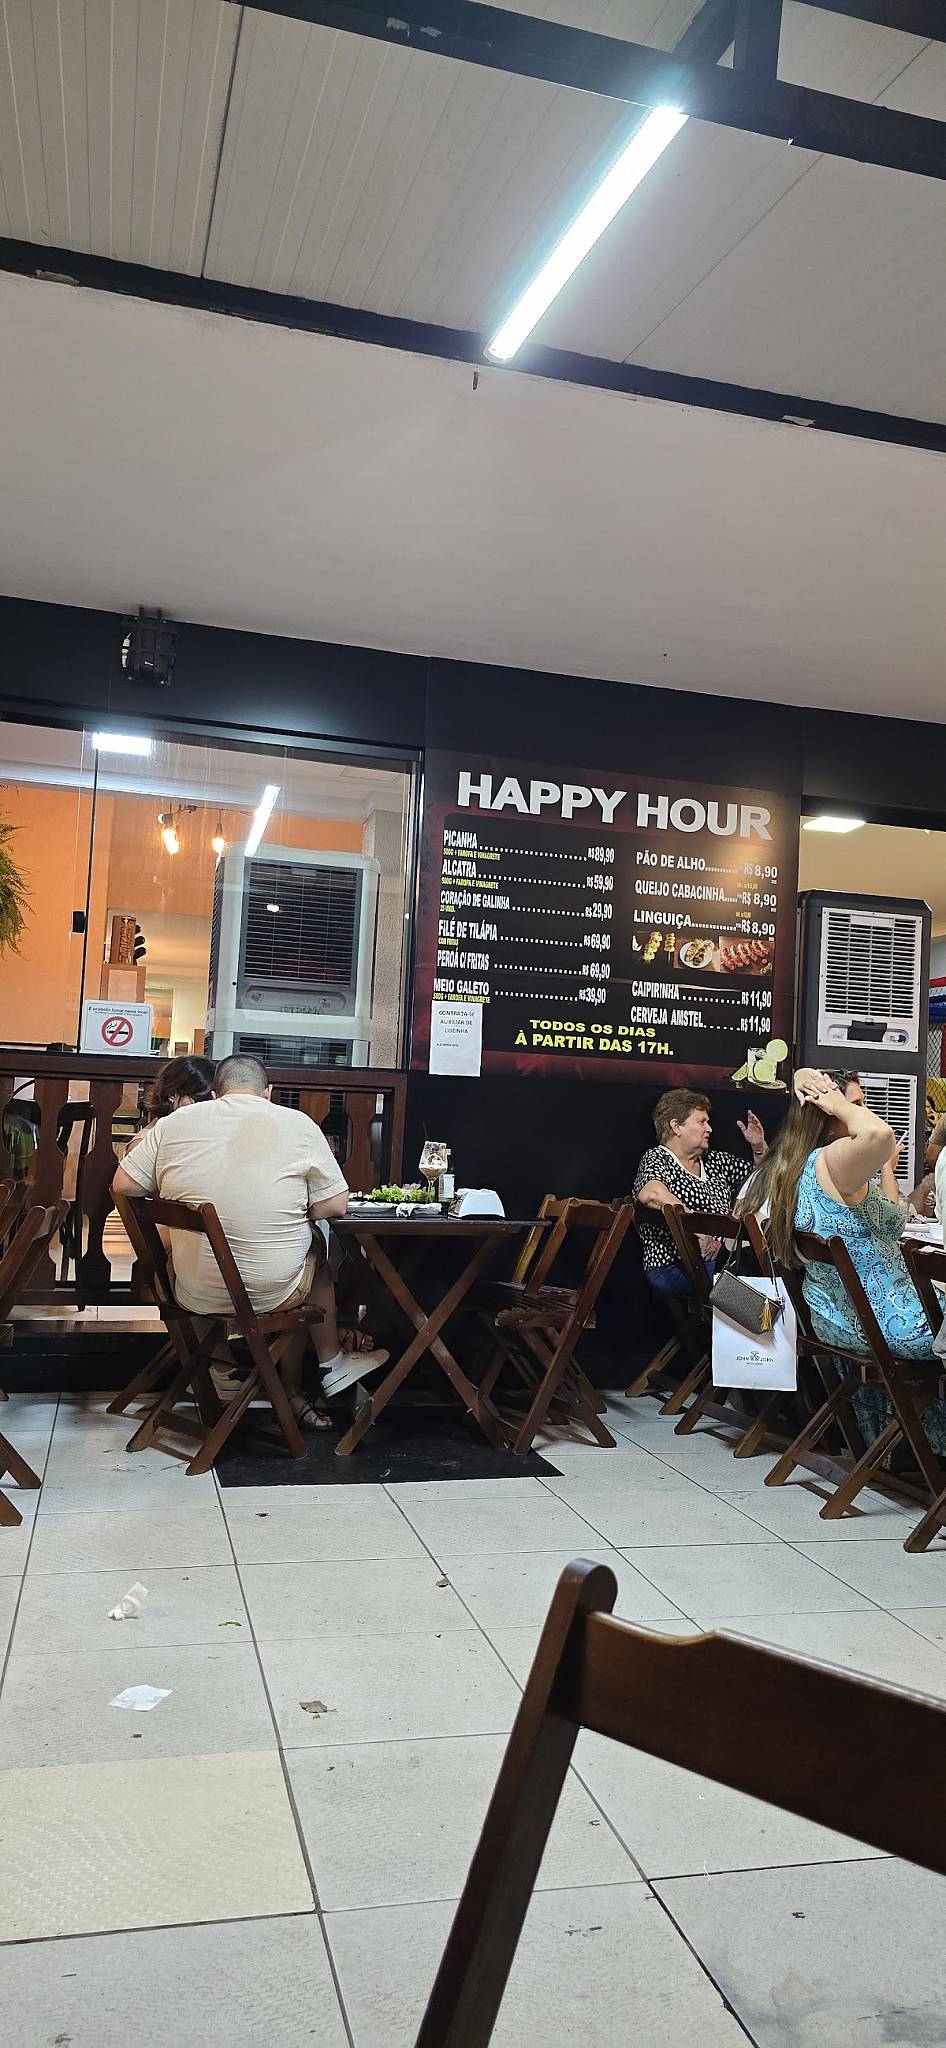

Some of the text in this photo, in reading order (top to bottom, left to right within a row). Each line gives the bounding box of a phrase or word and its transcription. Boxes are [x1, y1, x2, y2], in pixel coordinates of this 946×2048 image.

[457, 771, 773, 841] HAPPY HOUR
[444, 830, 478, 849] PICANHA
[442, 859, 476, 878] ALCATRA
[636, 850, 657, 866] PÃO
[660, 854, 674, 868] DE
[677, 856, 706, 871] ALHO
[440, 889, 471, 908] CORAÇÃO
[472, 893, 481, 907] DE
[482, 894, 510, 910] GALINHA
[635, 880, 669, 896] QUEIJO
[671, 883, 725, 901] CABACINHA
[438, 916, 455, 937] FILÉ
[456, 921, 467, 938] DE
[468, 920, 498, 941] TILÁPIA
[633, 909, 692, 929] LINGUIÇA
[437, 947, 458, 968] PEROÁ
[467, 952, 490, 970] FRITAS
[434, 978, 454, 993] MEIO
[456, 979, 489, 995] GALETO
[632, 981, 680, 1000] CAIPIRINHA
[630, 1006, 668, 1024] CERVEJA
[670, 1009, 704, 1028] AMSTEL
[530, 1019, 656, 1037] TODOS OS DIAS
[515, 1030, 674, 1055] À PARTIR DAS 17H.
